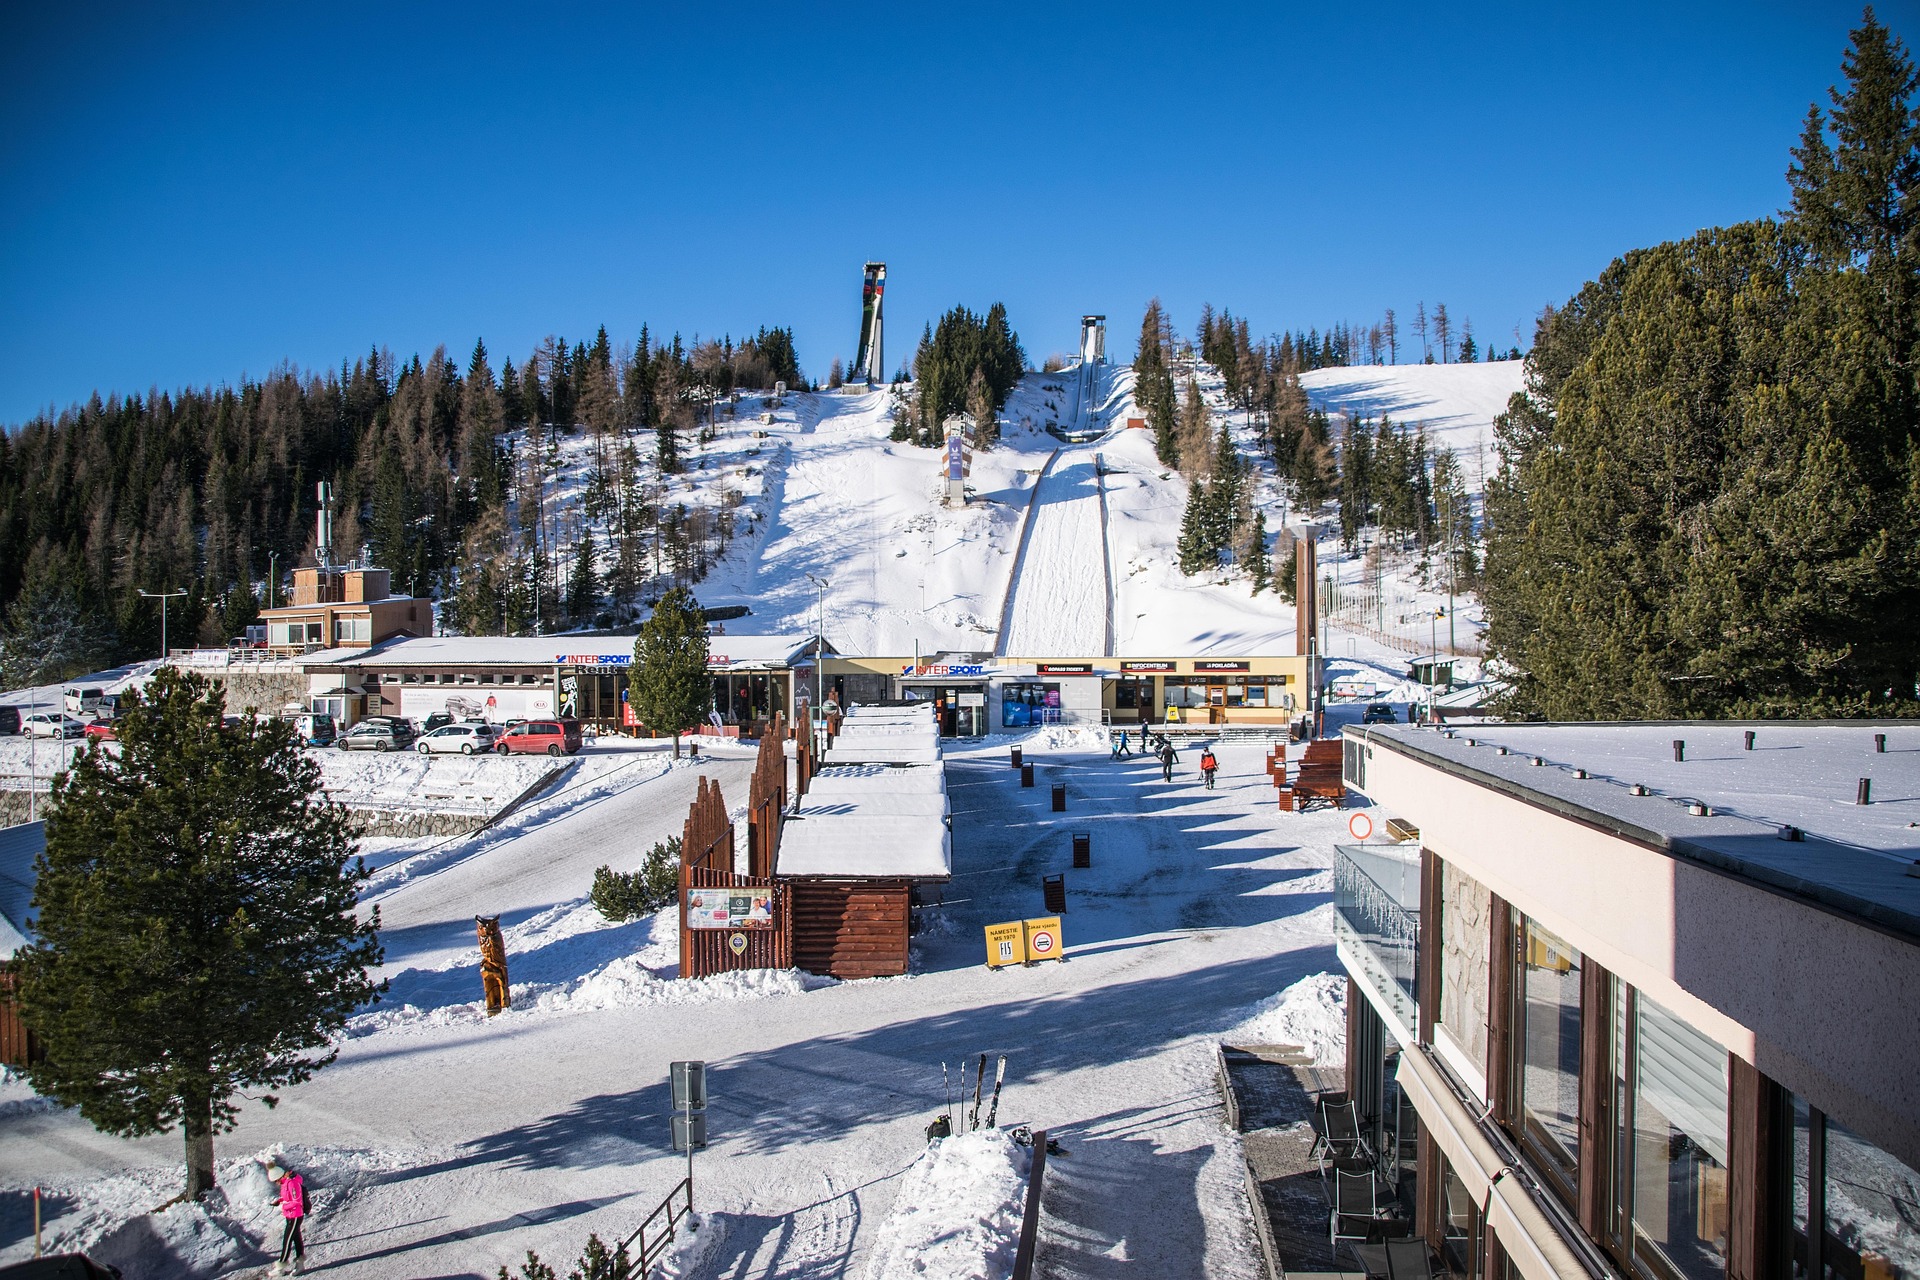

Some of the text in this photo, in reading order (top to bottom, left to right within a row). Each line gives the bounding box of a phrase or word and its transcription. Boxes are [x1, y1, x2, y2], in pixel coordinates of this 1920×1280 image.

[567, 655, 631, 664] INTERSPORT
[575, 665, 618, 674] Rent
[915, 665, 983, 675] INTERSPORT
[562, 681, 578, 692] SKI
[1000, 942, 1012, 955] FIS
